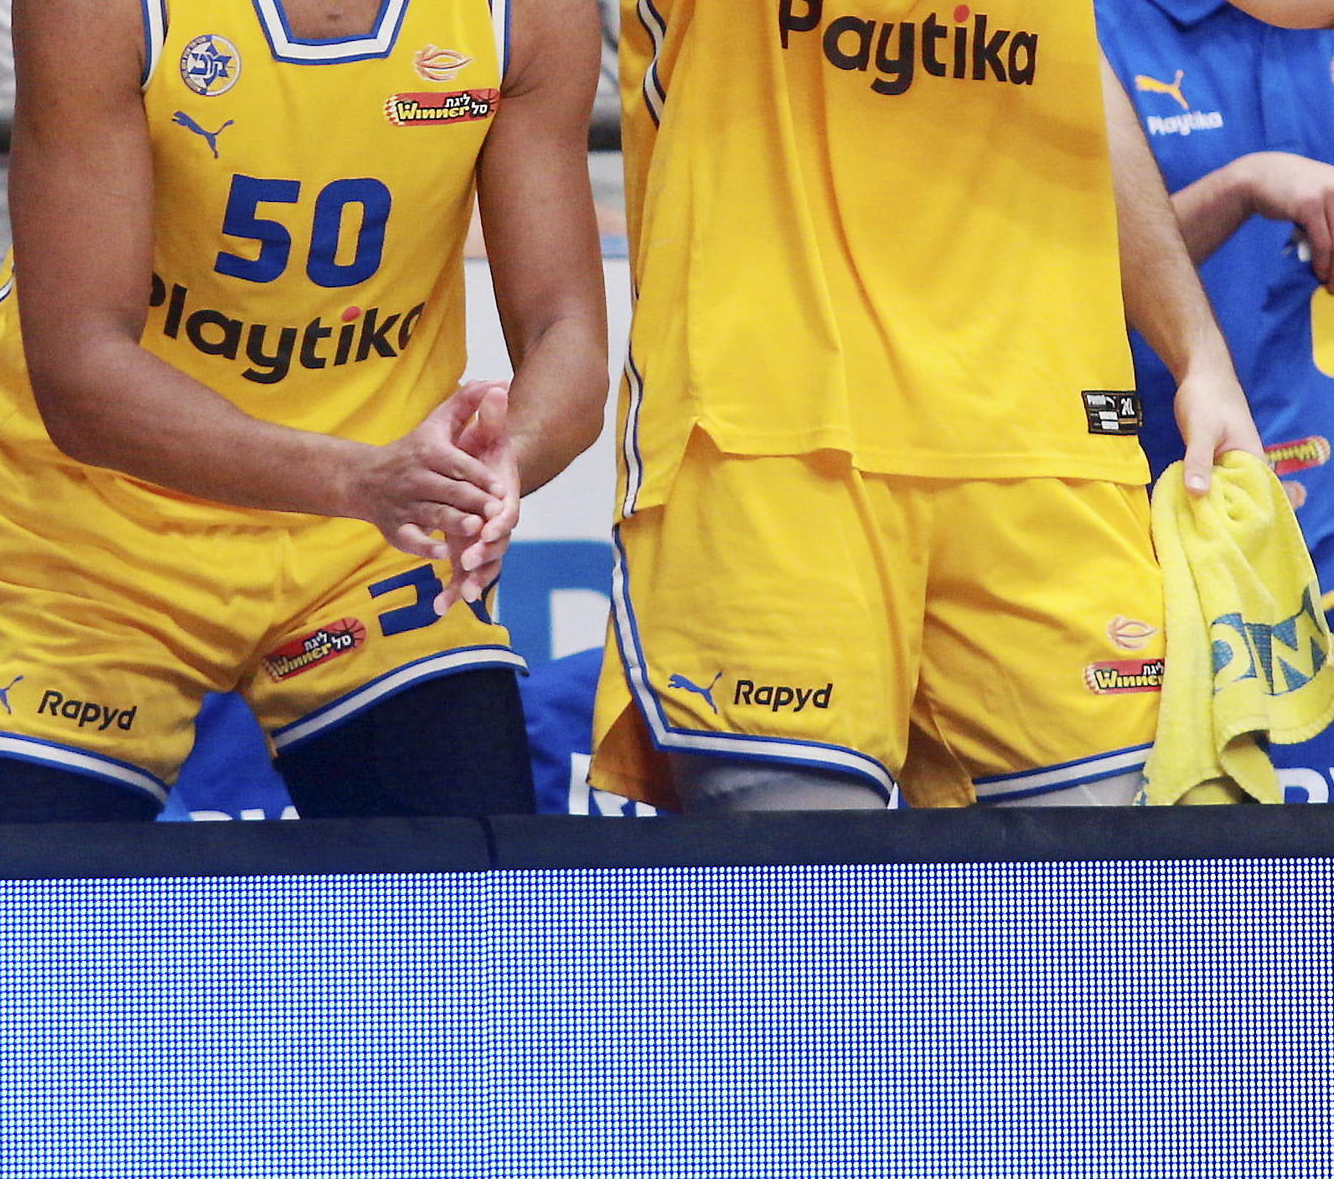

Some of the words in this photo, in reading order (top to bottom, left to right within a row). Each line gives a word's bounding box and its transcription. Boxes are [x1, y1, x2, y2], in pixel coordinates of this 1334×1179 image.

[397, 102, 470, 120] Winner
[214, 174, 392, 288] 50
[273, 643, 332, 676] Winner
[37, 689, 138, 732] Rapyd
[733, 679, 833, 713] Rapyd
